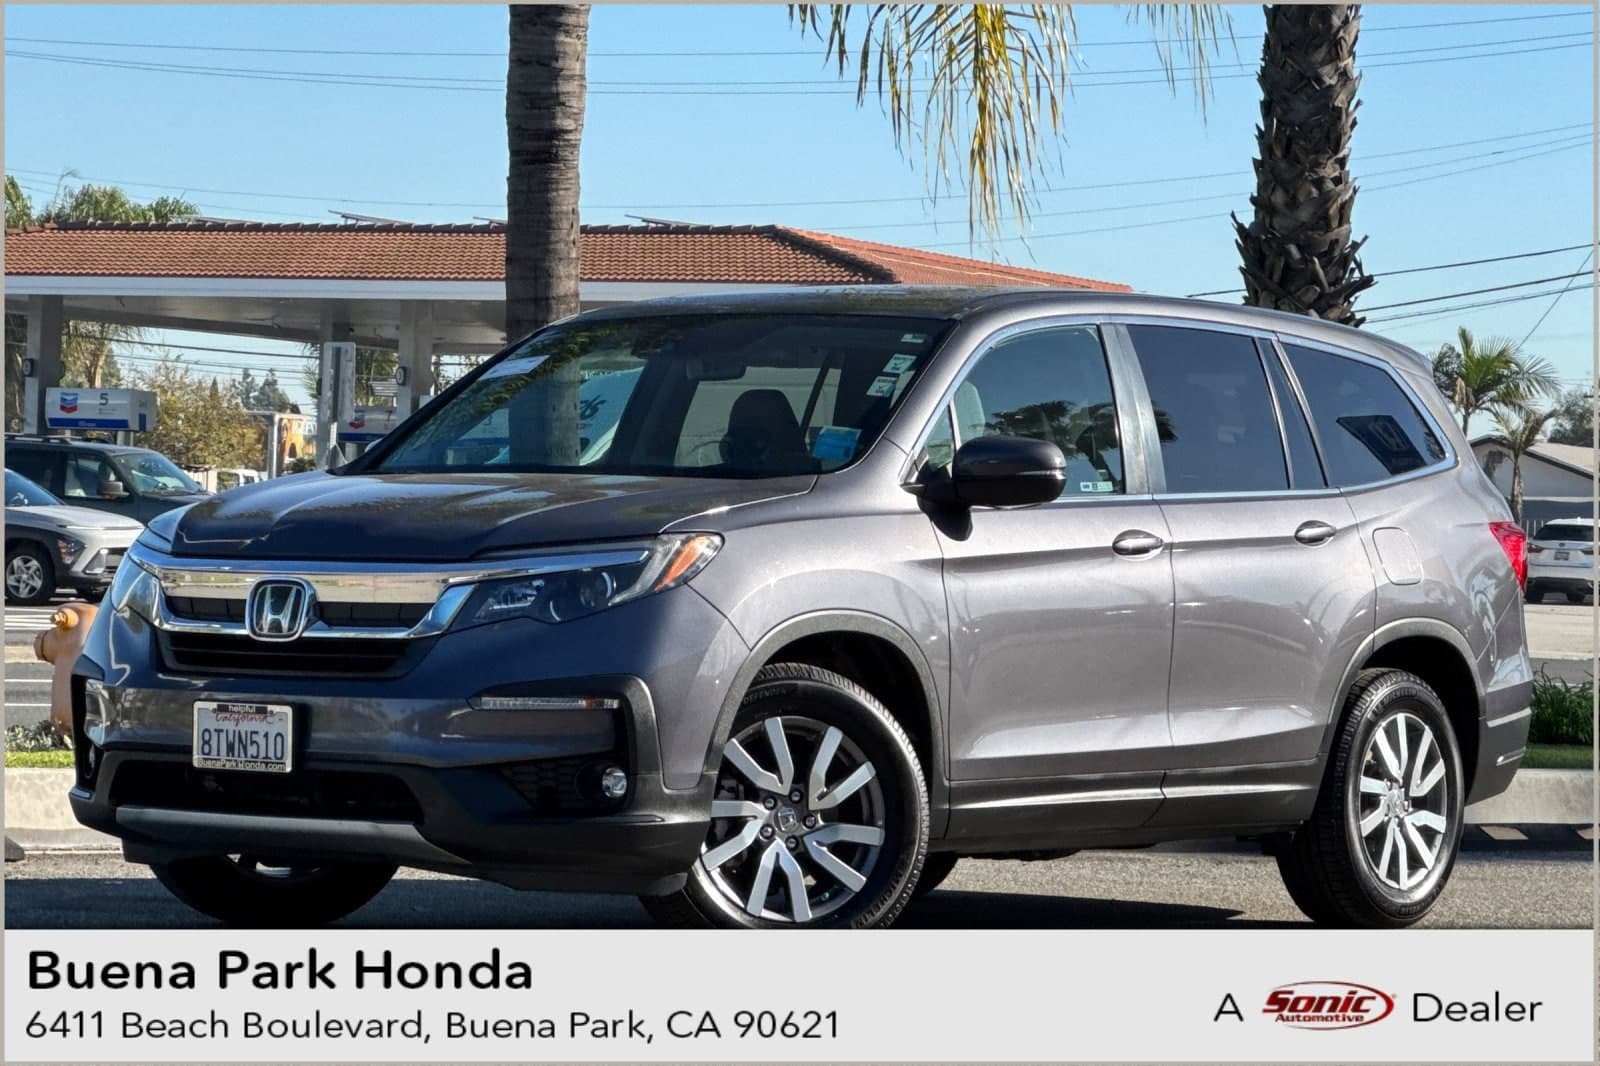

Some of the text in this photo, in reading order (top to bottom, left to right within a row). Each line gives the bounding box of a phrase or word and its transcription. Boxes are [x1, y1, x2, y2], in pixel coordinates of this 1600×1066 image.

[99, 392, 109, 406] 5
[228, 704, 256, 713] helpful
[201, 728, 285, 760] 8TWN510
